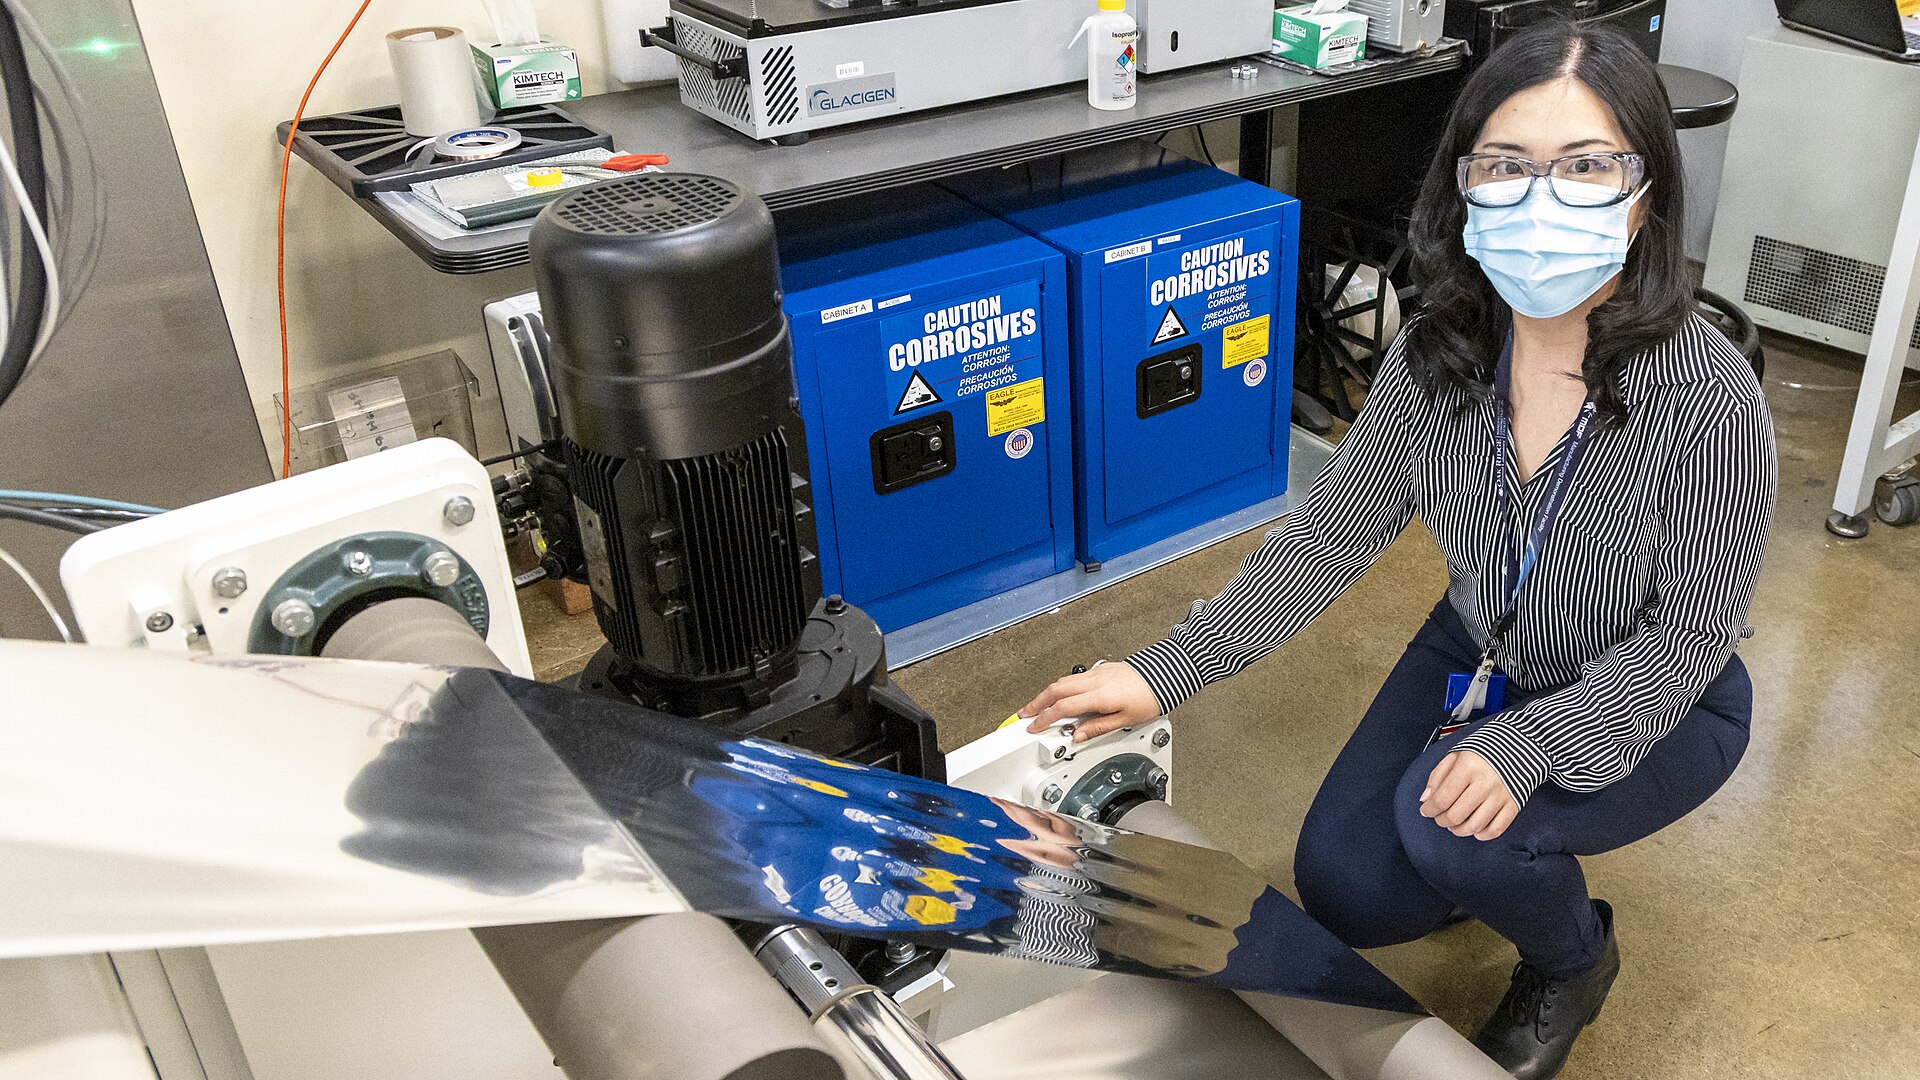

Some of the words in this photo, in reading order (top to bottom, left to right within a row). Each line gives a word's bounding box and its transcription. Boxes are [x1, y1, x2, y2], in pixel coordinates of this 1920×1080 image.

[1280, 20, 1307, 35] KIMTECH
[1328, 35, 1359, 47] KIMTECH
[513, 71, 564, 84] KIMTECH
[820, 87, 895, 110] GLACIGEN
[1111, 247, 1139, 259] CABINET
[1181, 237, 1244, 272] CAUTION
[1150, 250, 1270, 306] CORROSIVES
[1207, 284, 1248, 301] ATTENTION:
[1207, 291, 1247, 309] CORROSIF
[823, 305, 859, 320] CABINET
[923, 295, 1002, 334] CAUTION
[1201, 310, 1251, 331] CORROSIVOS
[1203, 301, 1249, 322] PRECAUCIÓN
[888, 308, 1037, 372] CORROSIVES
[1226, 325, 1246, 335] EAGLE
[961, 345, 1011, 365] ATTENTION:
[962, 353, 1011, 374] CORROSIF
[957, 373, 1018, 397] CORROSIVOS
[959, 364, 1014, 388] PRECAUCIÓN
[989, 388, 1015, 400] EAGLE
[1558, 440, 1579, 478] Manufacturing
[1544, 477, 1564, 515] Demonstration
